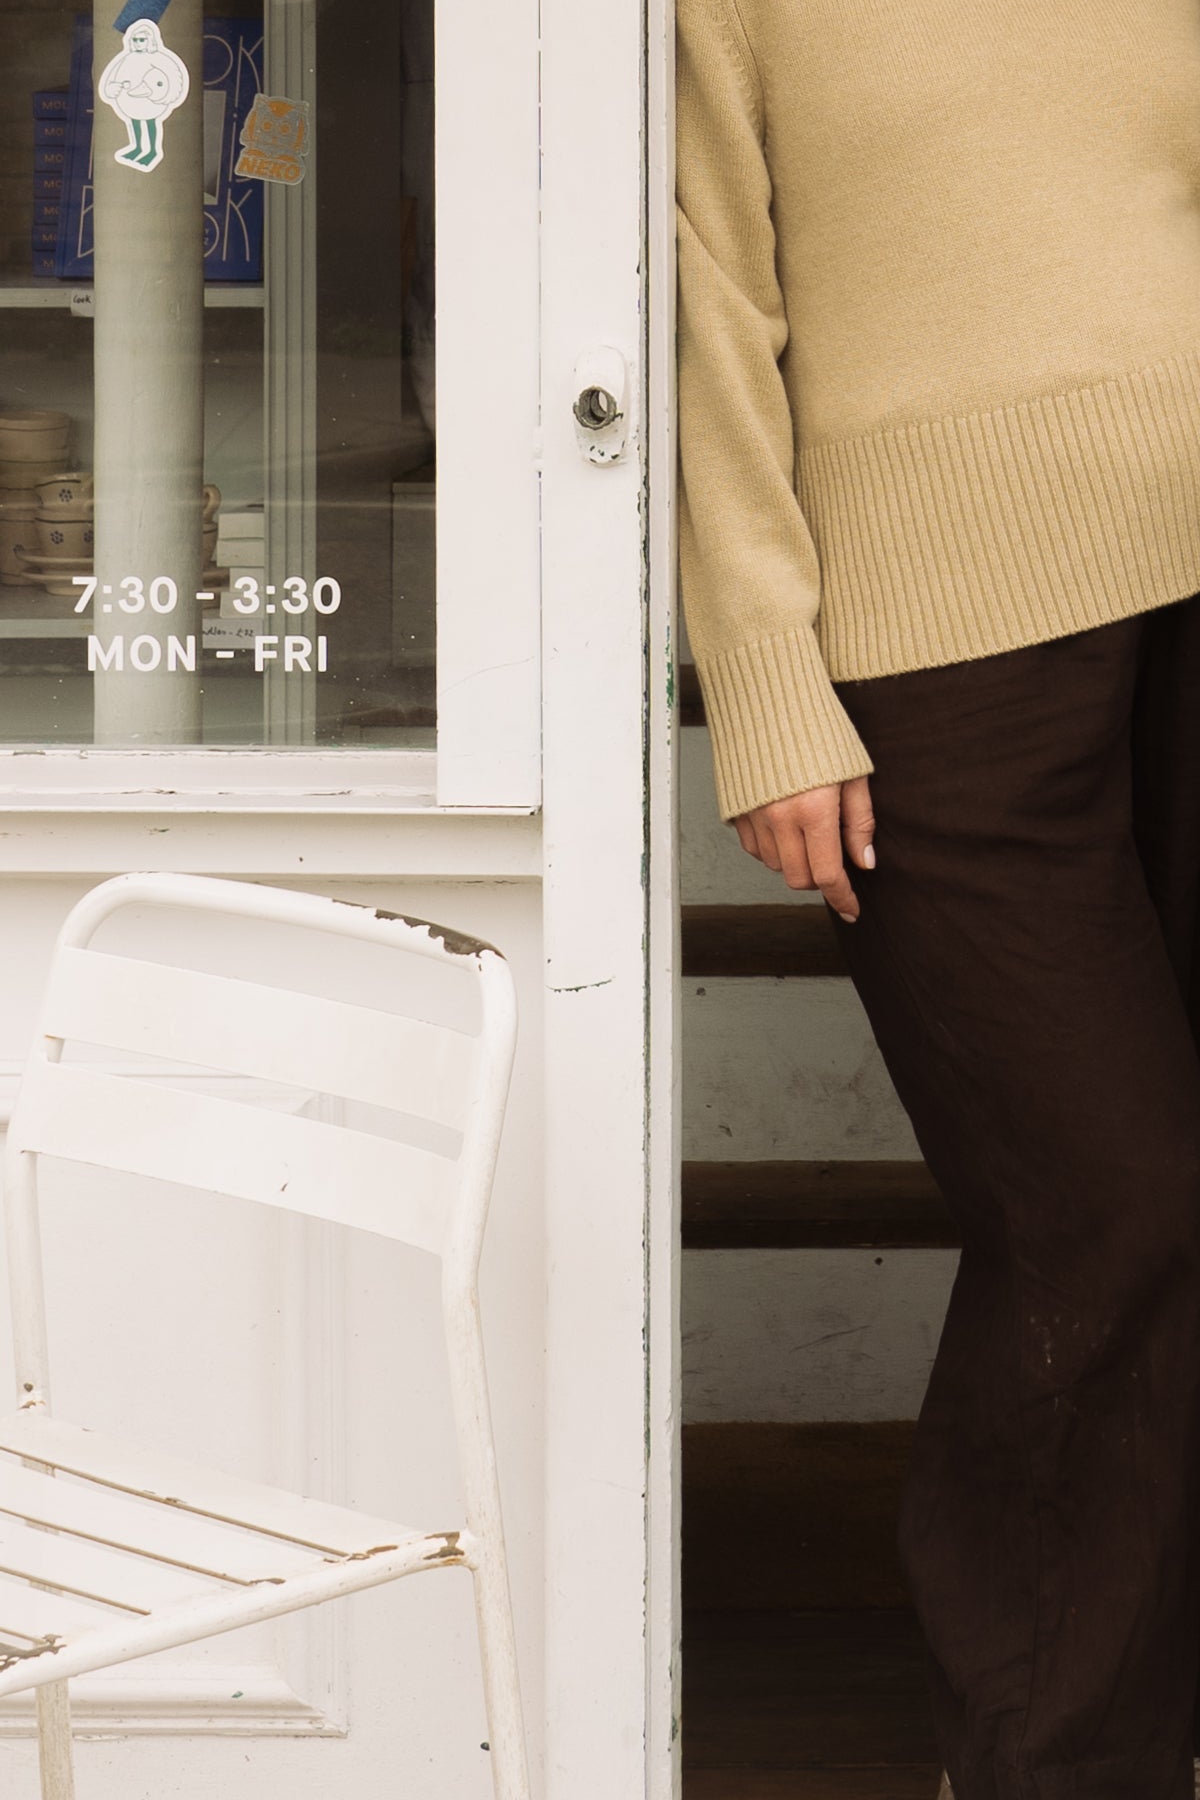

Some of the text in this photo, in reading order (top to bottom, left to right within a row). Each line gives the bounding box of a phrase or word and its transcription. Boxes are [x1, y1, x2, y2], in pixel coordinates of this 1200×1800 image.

[238, 156, 301, 183] NEKO
[71, 576, 342, 614] 7:30 - 3:30
[87, 635, 328, 673] MON - FRI
